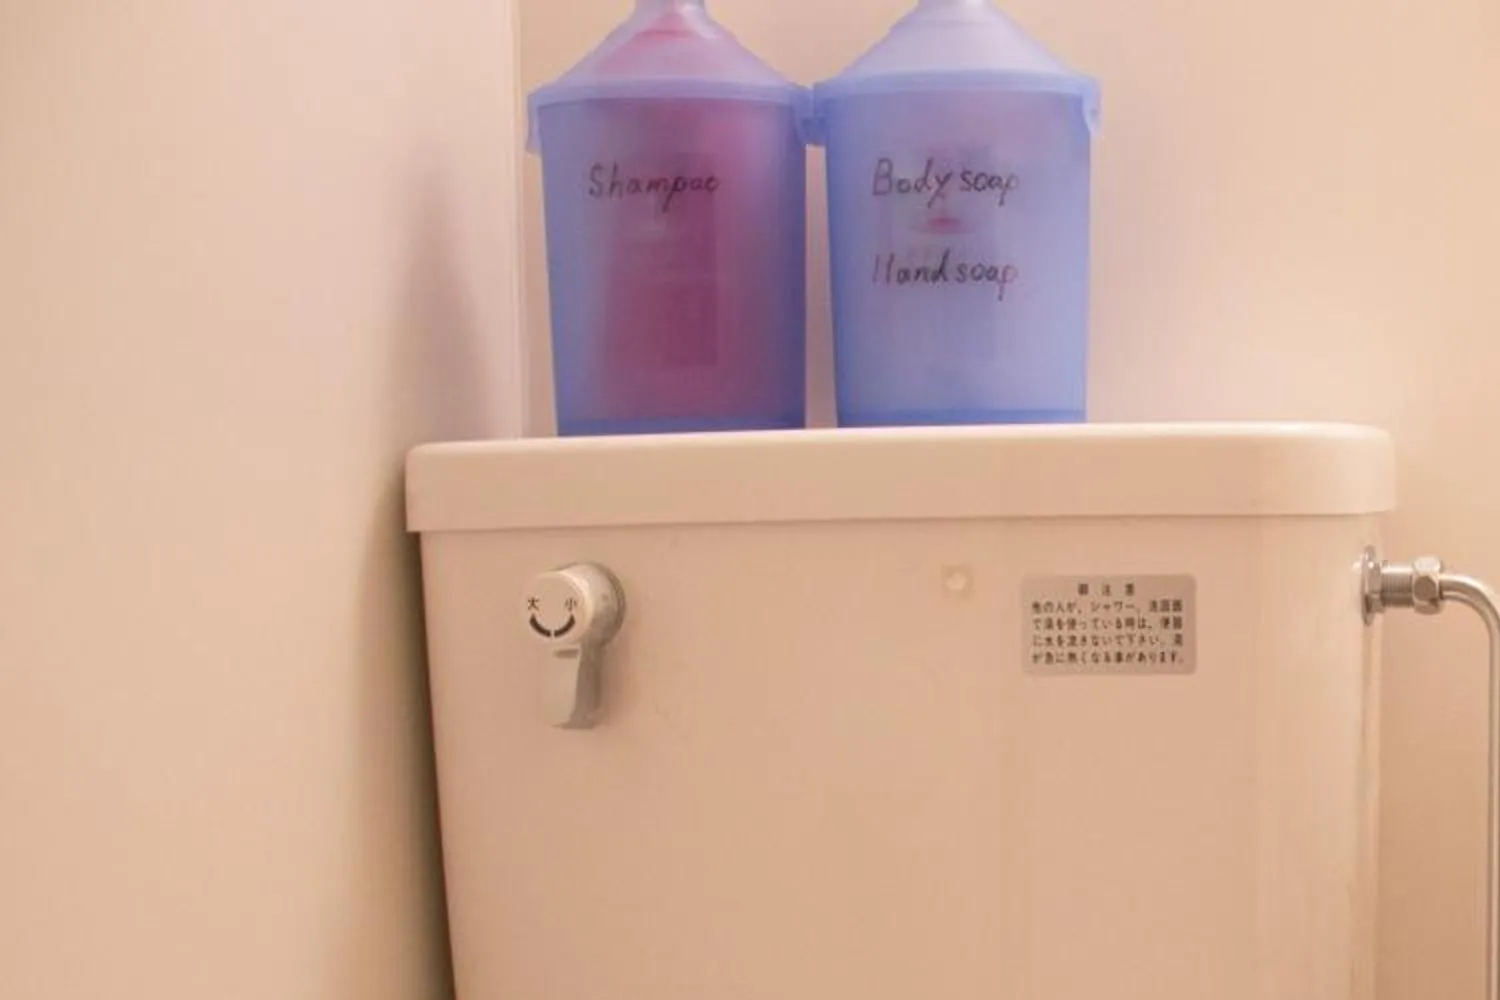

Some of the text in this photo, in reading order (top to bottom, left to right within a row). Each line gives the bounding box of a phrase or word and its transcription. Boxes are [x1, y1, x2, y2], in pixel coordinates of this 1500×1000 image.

[872, 157, 1020, 209] Body soap
[955, 262, 1020, 302] soap
